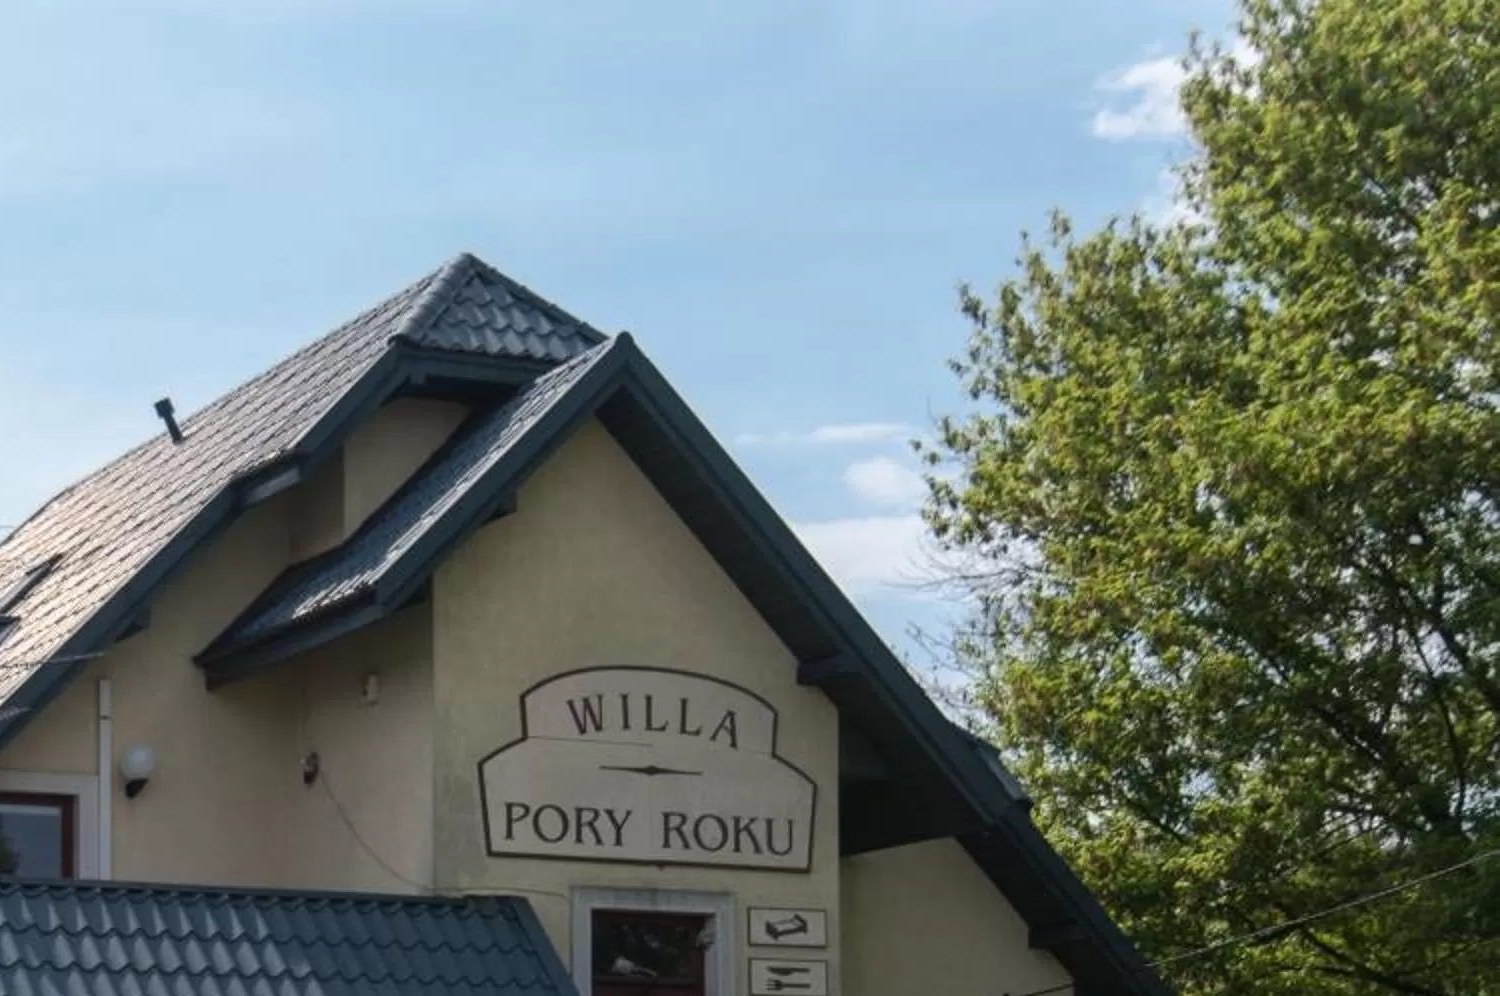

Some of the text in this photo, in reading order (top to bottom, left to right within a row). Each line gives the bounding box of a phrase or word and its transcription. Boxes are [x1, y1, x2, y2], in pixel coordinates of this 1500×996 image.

[567, 693, 739, 750] WILLA
[504, 802, 794, 856] PORY ROKU
